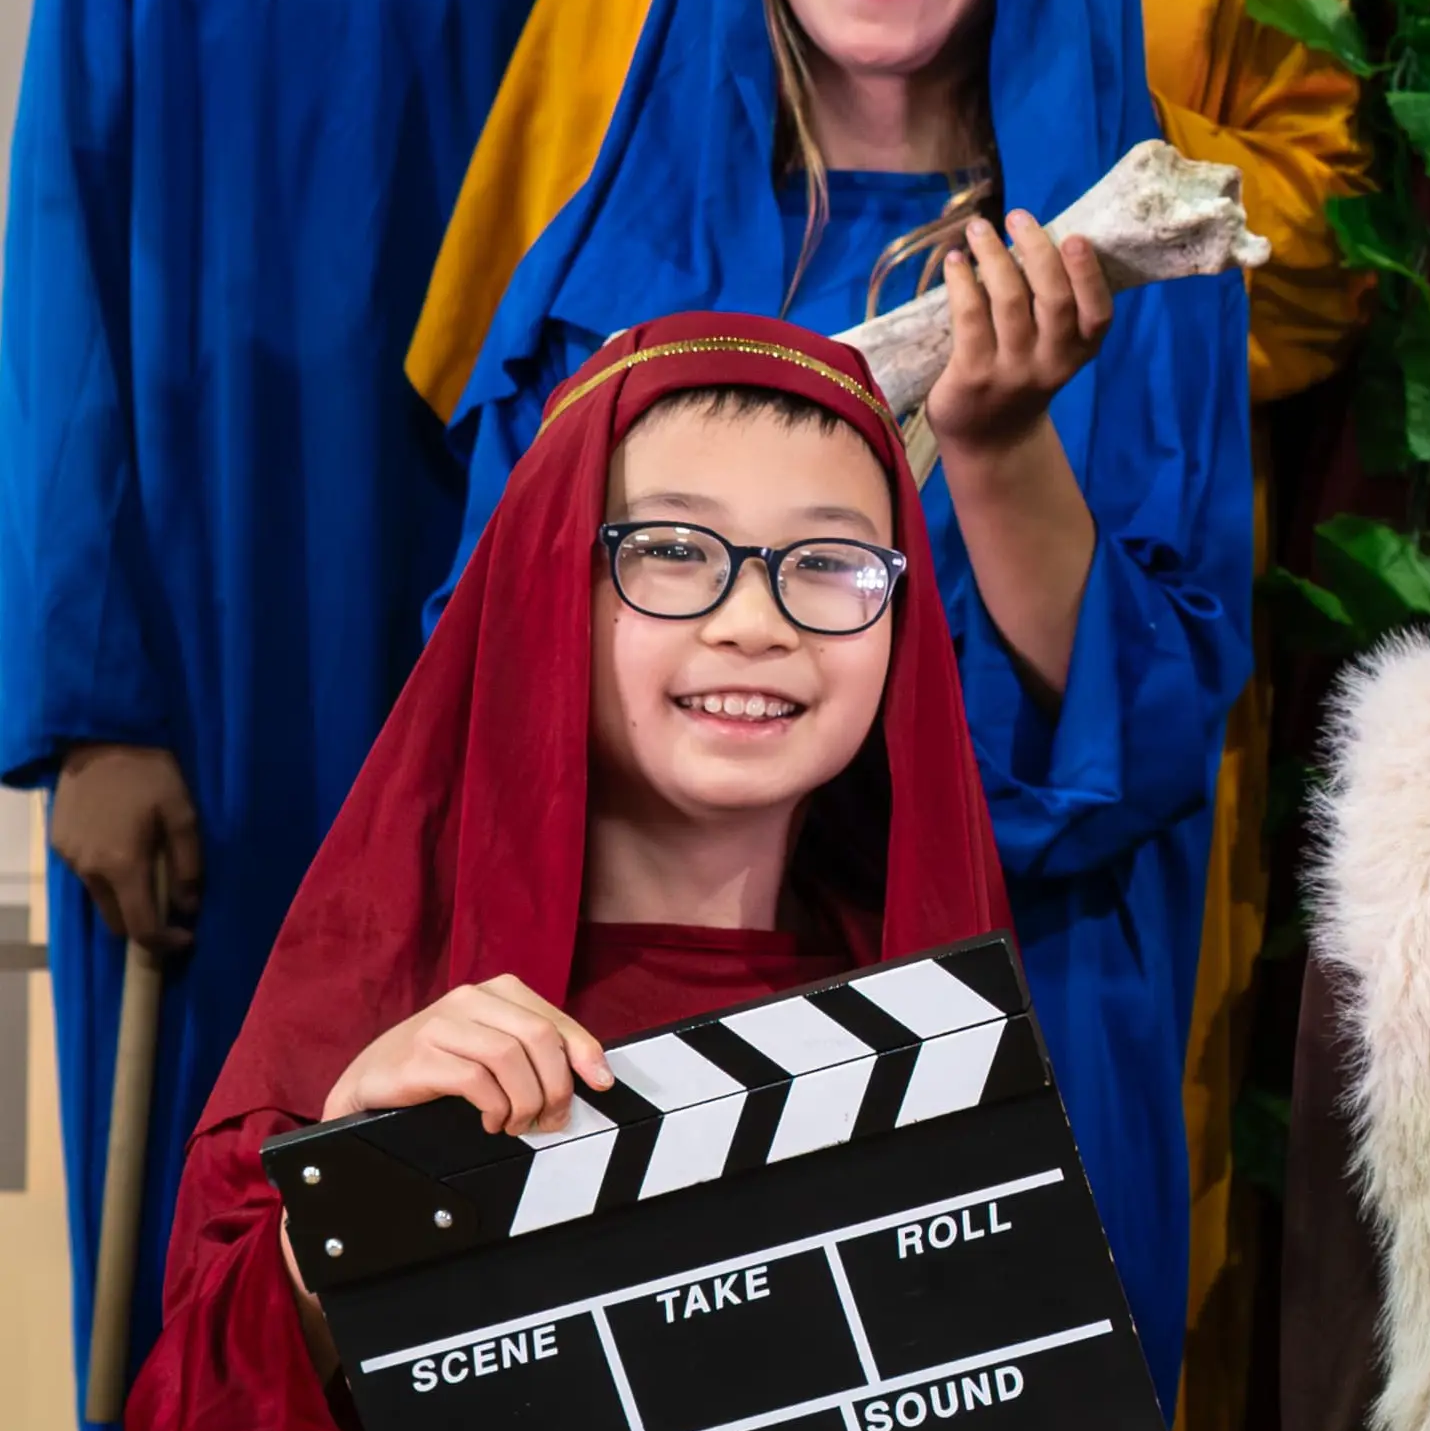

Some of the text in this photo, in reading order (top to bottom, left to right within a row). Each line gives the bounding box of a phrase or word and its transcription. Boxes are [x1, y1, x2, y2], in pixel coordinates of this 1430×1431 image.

[897, 1201, 1012, 1259] ROLL
[656, 1265, 770, 1324] TAKE
[412, 1324, 558, 1392] SCENE
